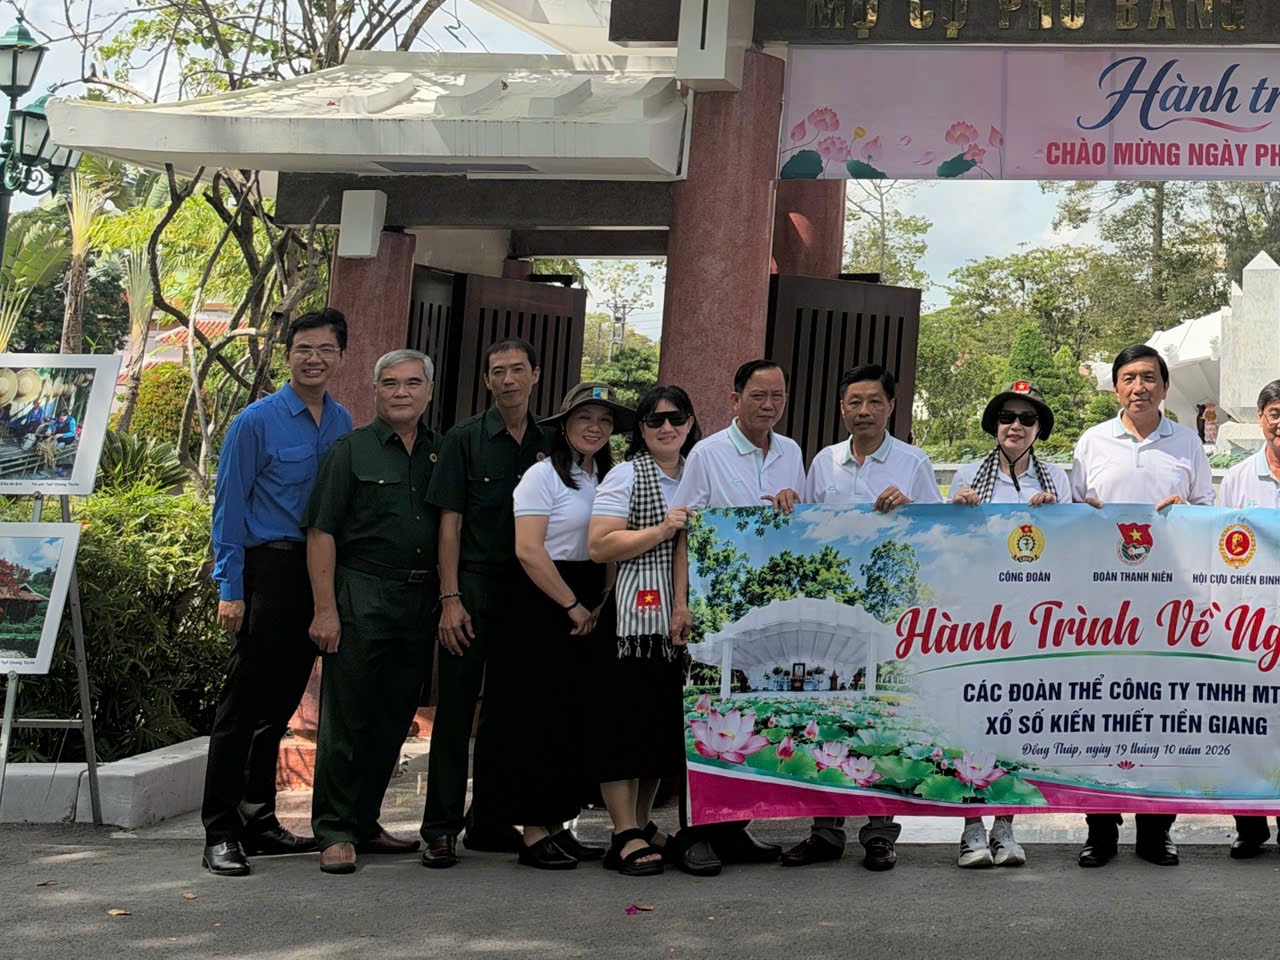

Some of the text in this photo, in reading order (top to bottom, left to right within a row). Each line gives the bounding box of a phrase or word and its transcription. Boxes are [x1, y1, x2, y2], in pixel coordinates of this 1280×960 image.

[1076, 56, 1242, 131] Hành
[1046, 138, 1106, 165] CHÀO
[1113, 138, 1181, 166] MỪNG
[1188, 139, 1248, 167] NGÀY
[999, 570, 1051, 582] CÔNG ĐOÀN
[1093, 570, 1173, 583] ĐOÀN THANH NIÊN
[1192, 572, 1208, 585] HỘI
[1230, 572, 1257, 586] CHIẾN
[1259, 575, 1280, 586] BINH
[895, 607, 1017, 660] Hành
[1029, 600, 1145, 650] Trình
[1156, 599, 1222, 648] Về
[963, 680, 1002, 702] CÁC
[1008, 679, 1062, 702] ĐOÀN
[1068, 674, 1105, 700] THỂ
[1109, 678, 1162, 701] CÔNG
[1168, 682, 1190, 701] TY
[1196, 683, 1246, 703] TNHH
[985, 708, 1268, 736] XỔ SỐ KIẾN THIẾT TIỀN GIANG
[1021, 743, 1050, 760] Đồng
[1085, 743, 1112, 759] ngày
[1115, 743, 1128, 756] 19
[1130, 742, 1160, 759] tháng
[1163, 744, 1176, 755] 10
[1178, 744, 1202, 755] năm
[1205, 743, 1232, 756] 2026
